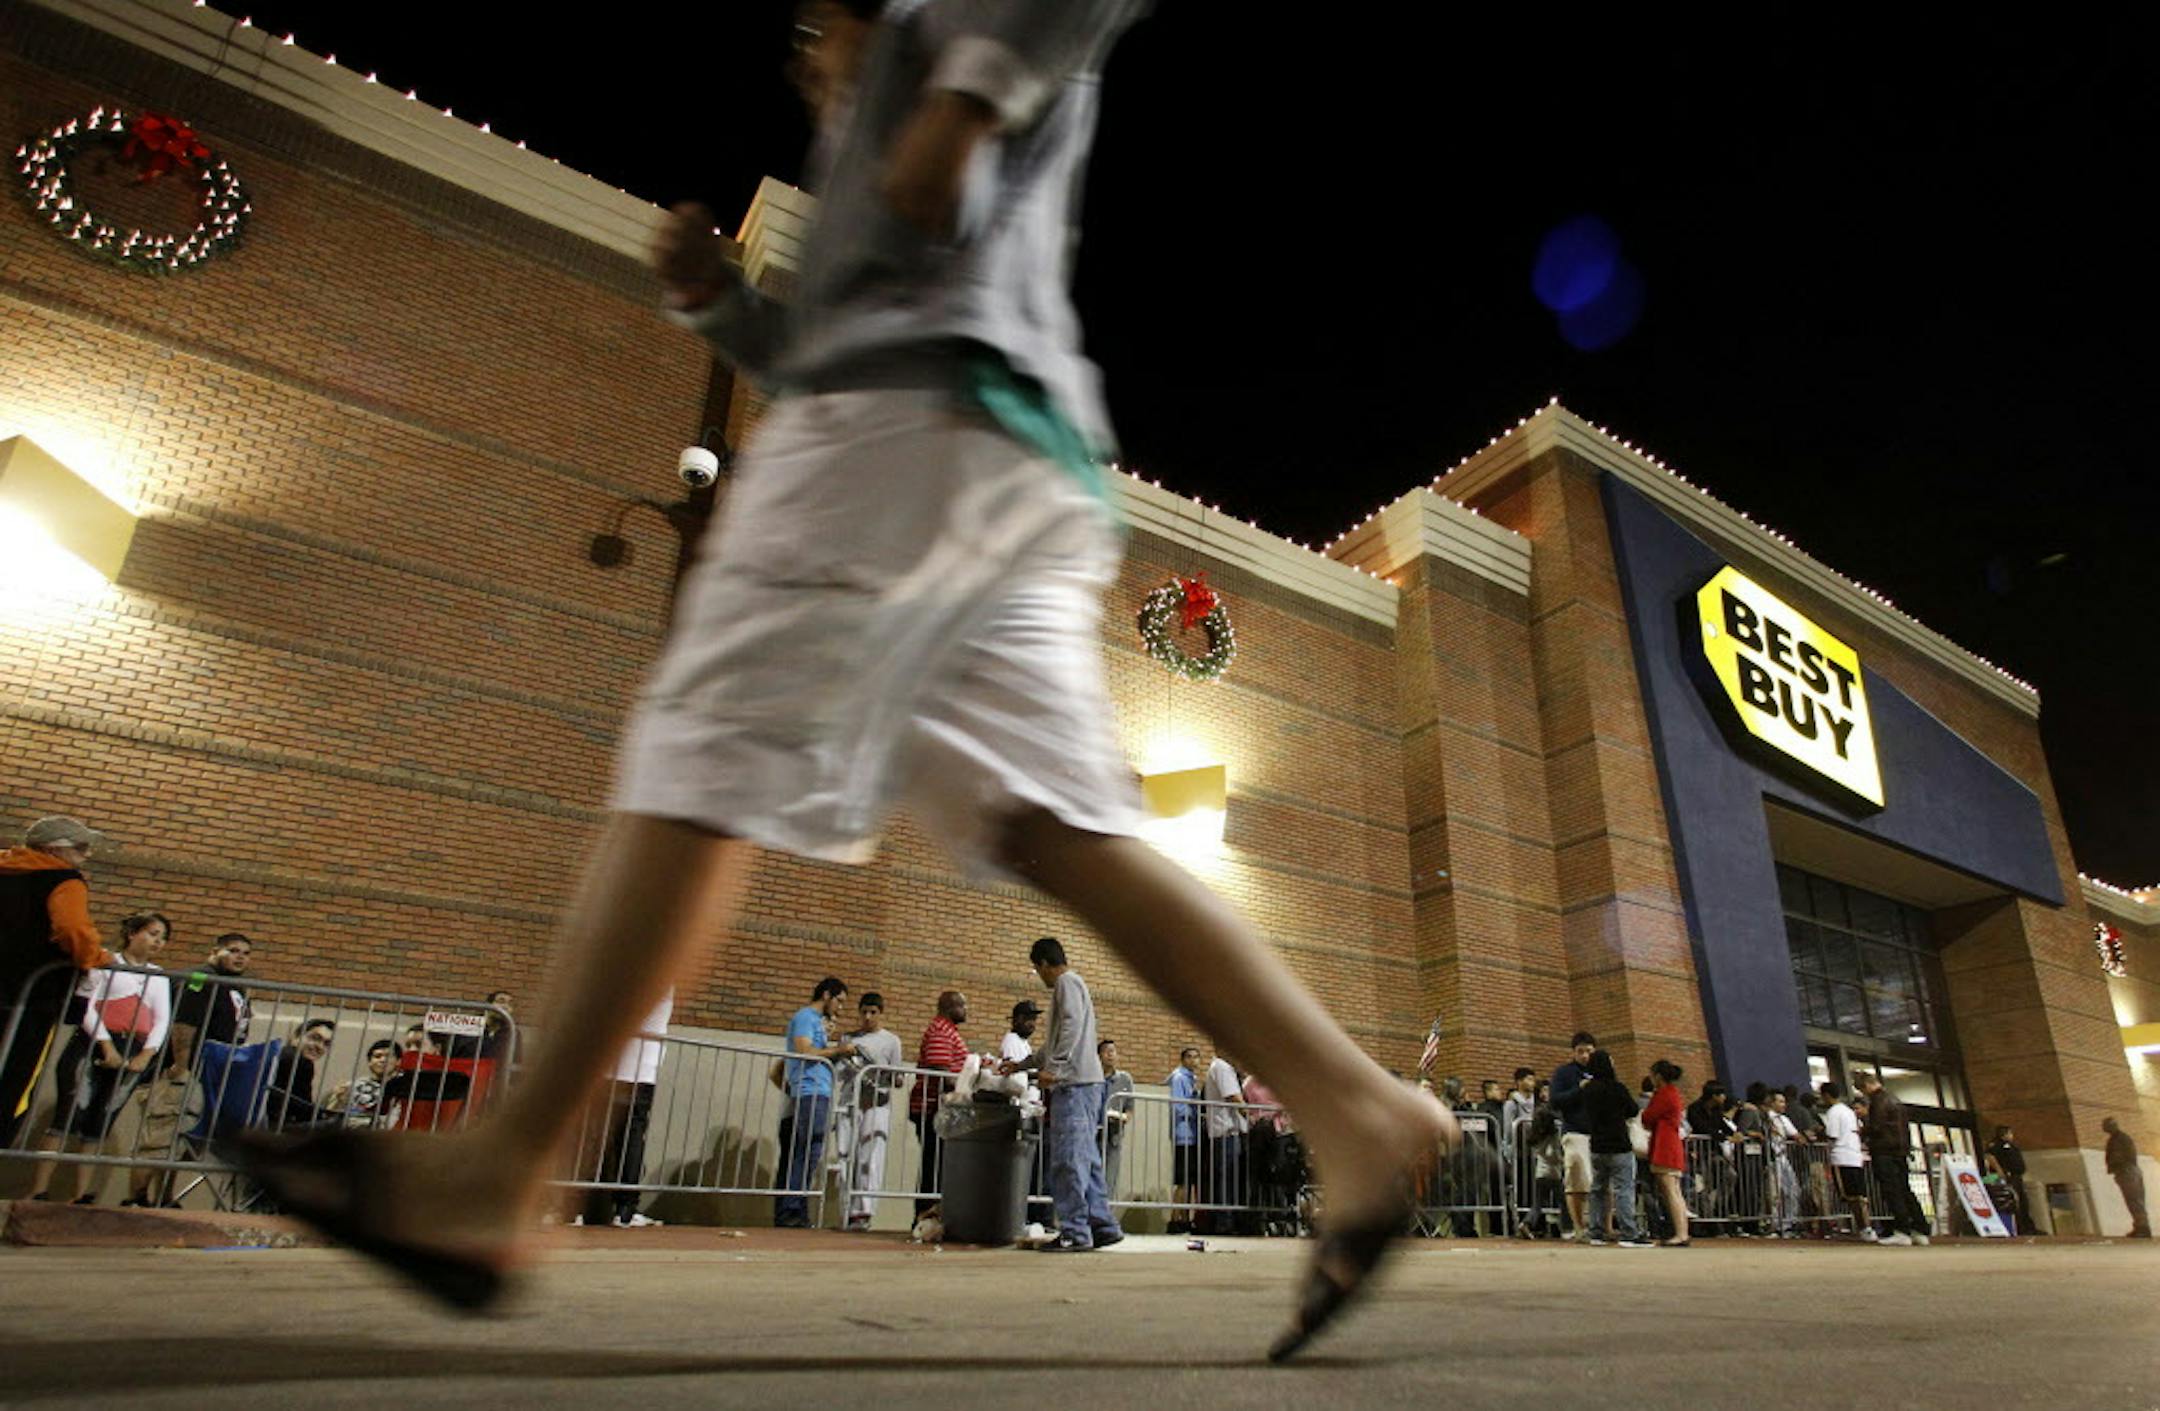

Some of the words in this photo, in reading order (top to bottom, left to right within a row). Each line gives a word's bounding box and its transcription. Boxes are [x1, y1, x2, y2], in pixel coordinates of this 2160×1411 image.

[1722, 588, 1856, 709] BEST
[1738, 653, 1854, 760] BUY
[427, 1013, 482, 1026] NATIONAL
